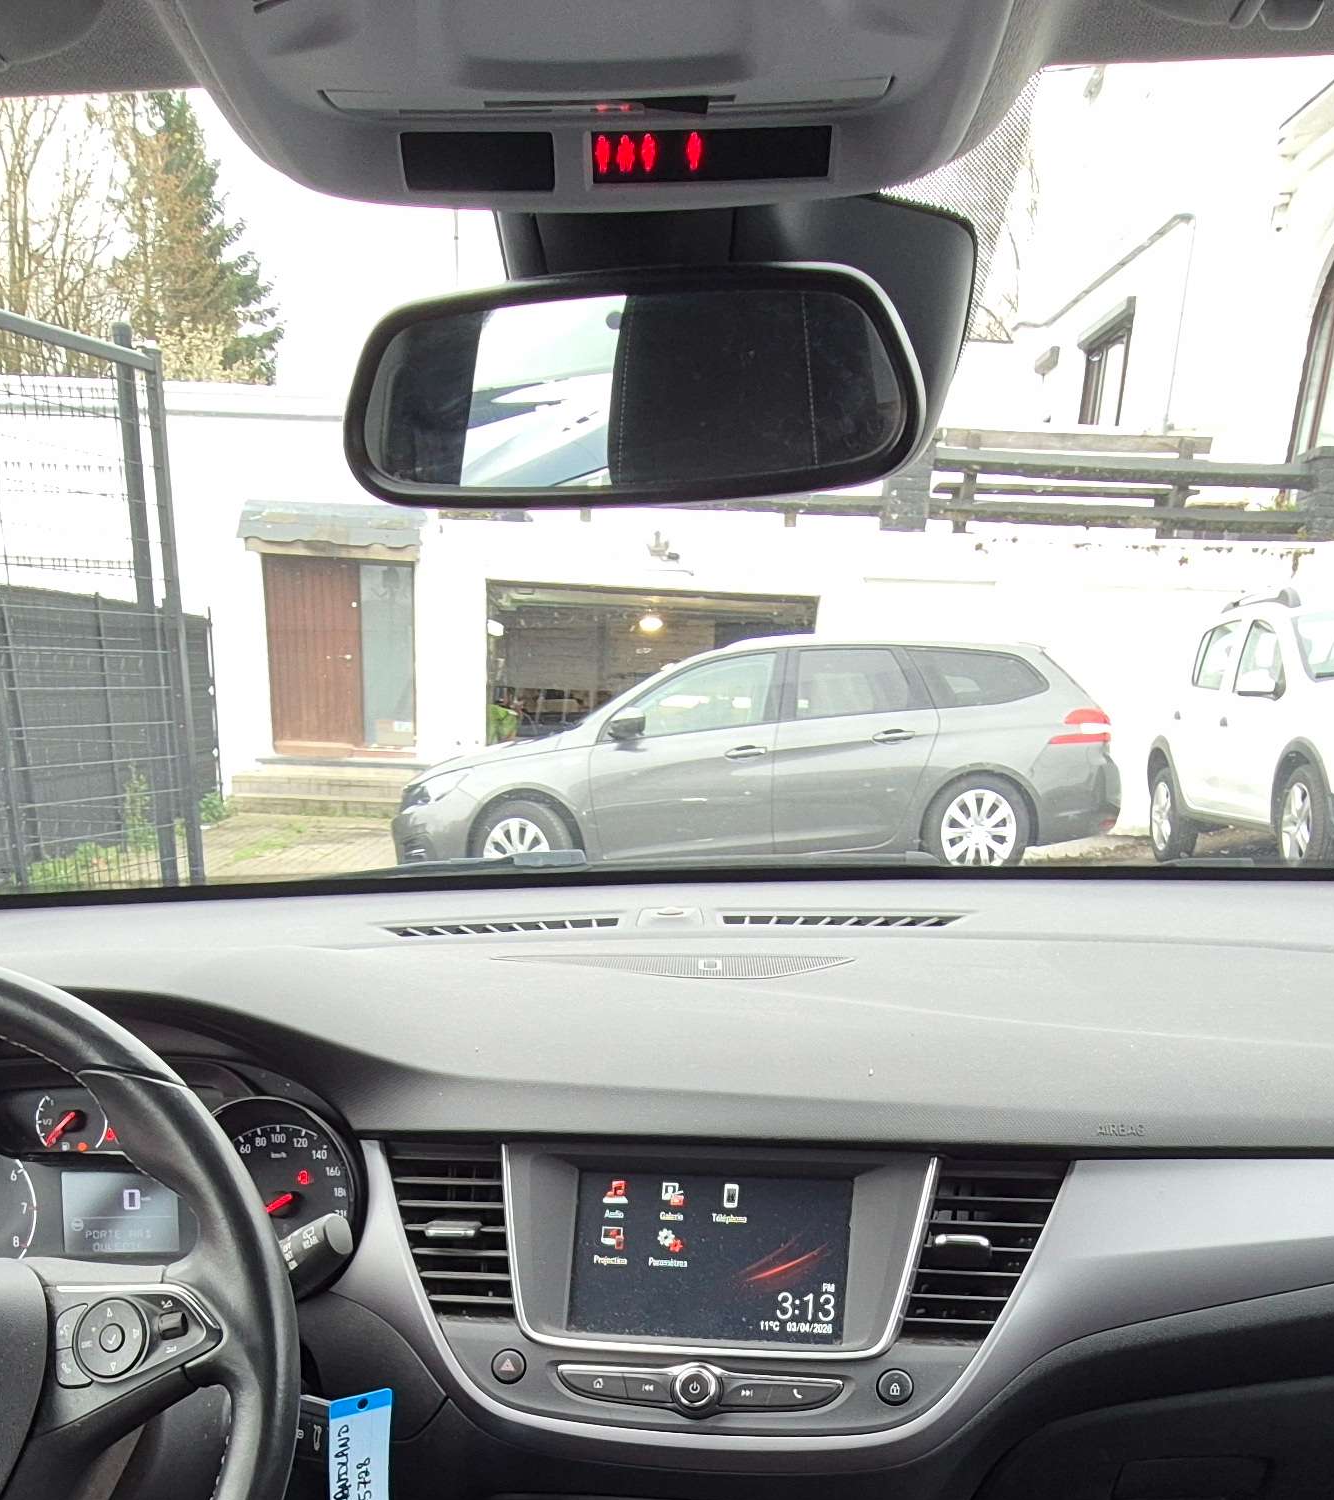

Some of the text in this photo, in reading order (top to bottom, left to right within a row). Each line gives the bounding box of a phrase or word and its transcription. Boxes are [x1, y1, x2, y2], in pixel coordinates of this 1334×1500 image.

[1096, 1122, 1147, 1137] AIRBAG
[255, 1136, 267, 1147] 80
[271, 1133, 286, 1143] 100
[293, 1138, 308, 1148] 120
[239, 1144, 251, 1153] 60
[312, 1150, 327, 1160] 140
[10, 1170, 17, 1182] 6
[325, 1166, 341, 1177] 160
[123, 1189, 141, 1210] 0
[21, 1202, 28, 1214] 7
[12, 1236, 20, 1248] 8
[776, 1292, 835, 1321] 3:13
[760, 1320, 780, 1331] 11°C
